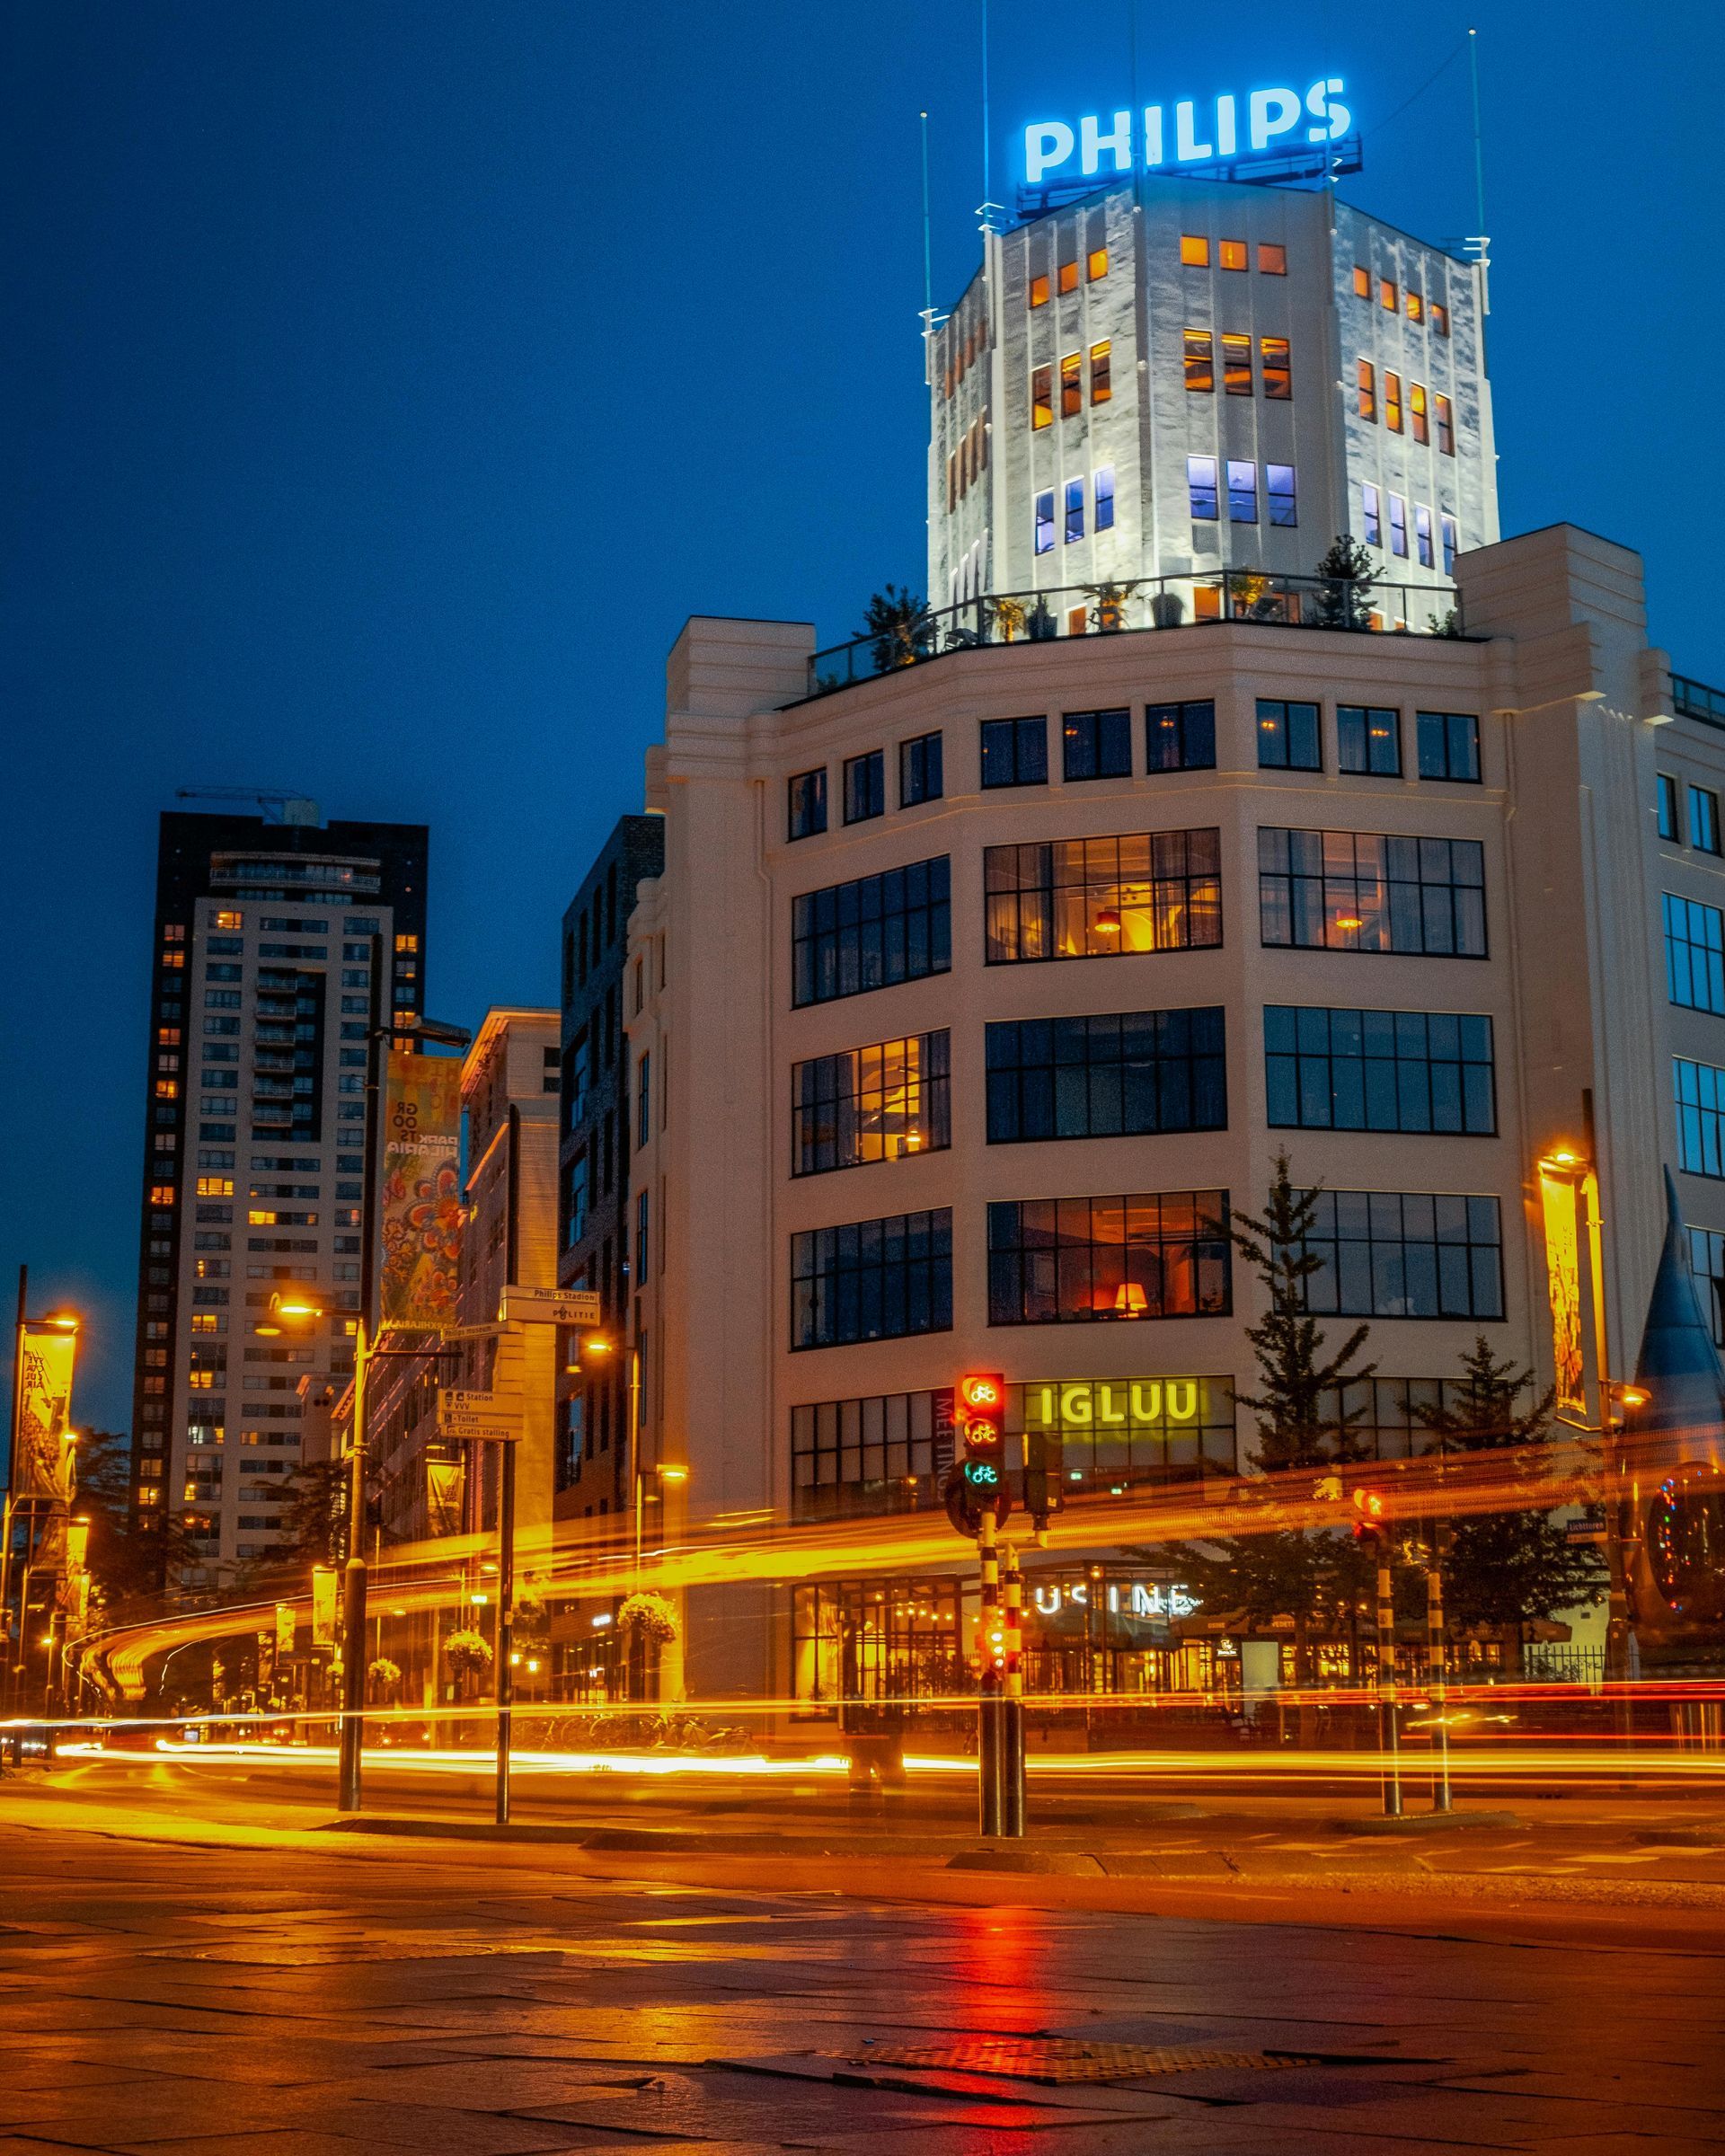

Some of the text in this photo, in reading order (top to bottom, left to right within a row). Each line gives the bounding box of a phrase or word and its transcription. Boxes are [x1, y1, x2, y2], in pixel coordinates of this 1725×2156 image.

[1025, 78, 1351, 182] PHILIPS
[534, 1289, 595, 1302] Philips Stadion
[466, 1393, 493, 1402] Station
[1041, 1383, 1197, 1425] IGLUU
[458, 1427, 509, 1438] Gratis stalling
